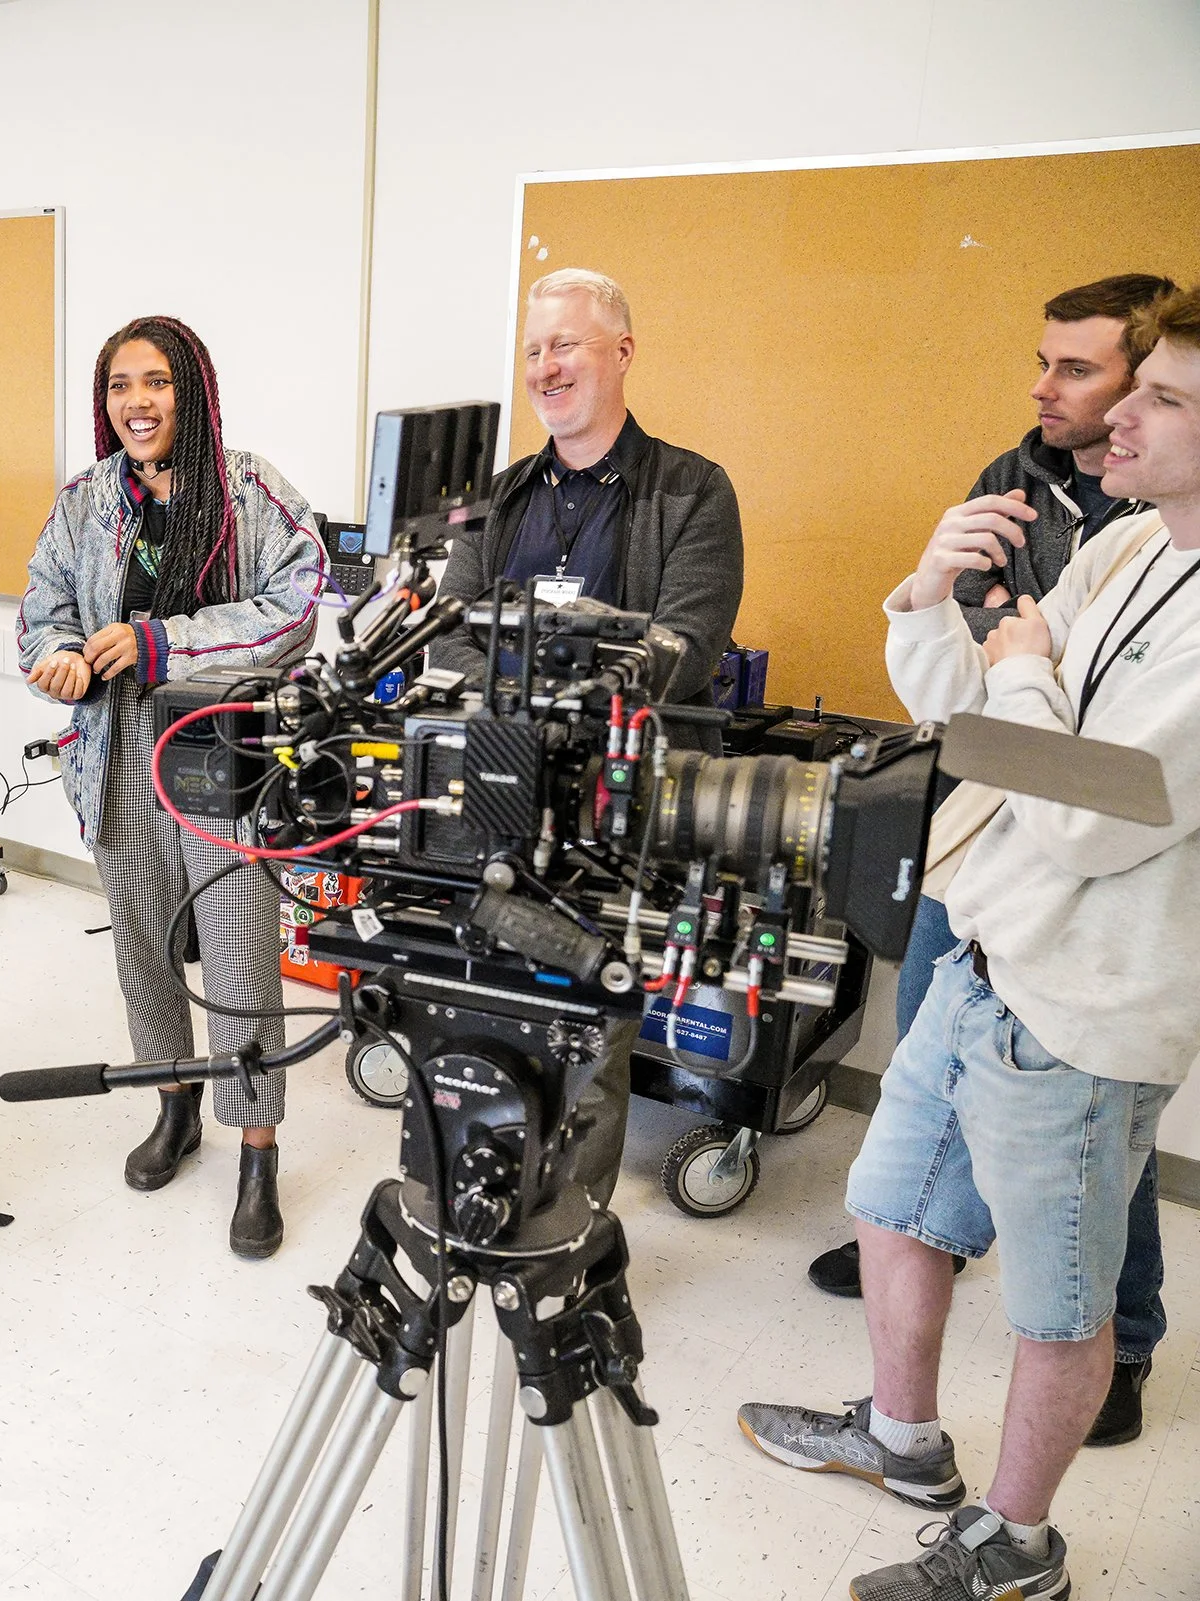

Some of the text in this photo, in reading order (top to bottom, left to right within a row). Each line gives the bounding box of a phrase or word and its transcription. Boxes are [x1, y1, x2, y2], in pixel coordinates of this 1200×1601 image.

[647, 1009, 727, 1034] ADORAARENTAL.COM
[662, 1024, 708, 1041] 2-627-8487
[915, 1436, 928, 1444] CK
[1010, 1537, 1027, 1545] CK
